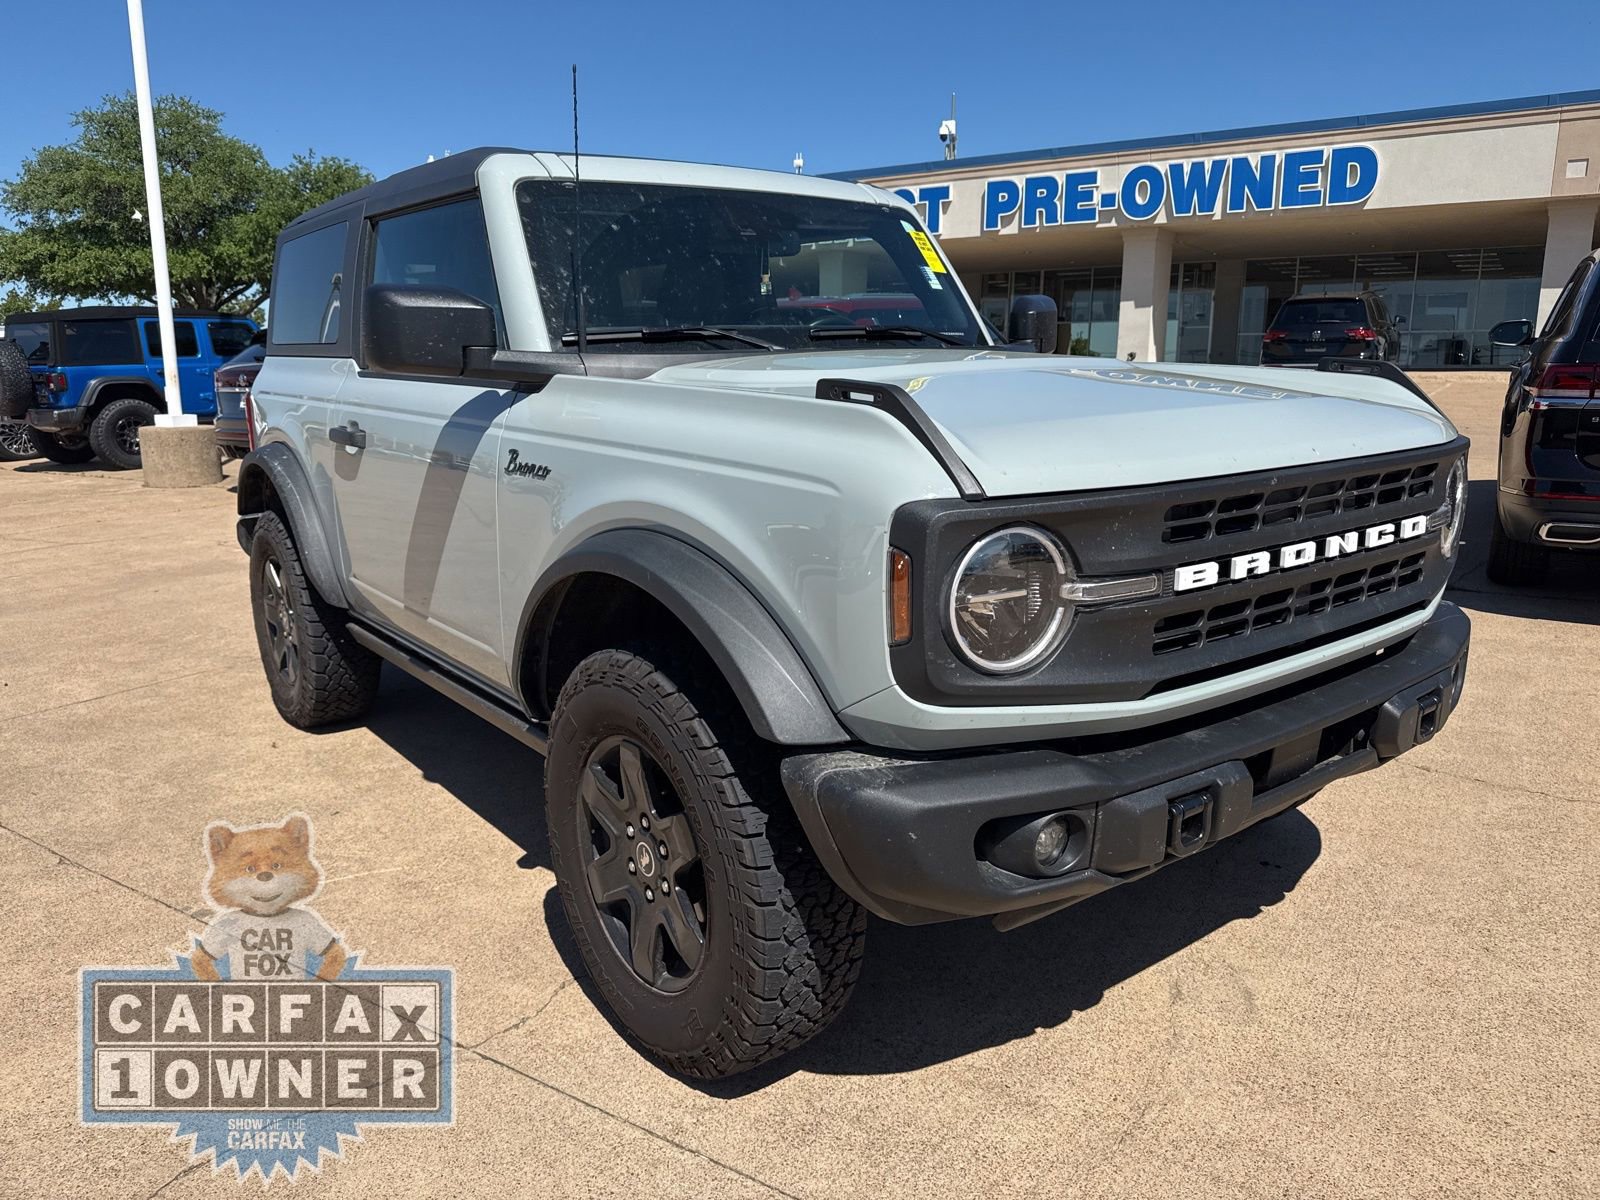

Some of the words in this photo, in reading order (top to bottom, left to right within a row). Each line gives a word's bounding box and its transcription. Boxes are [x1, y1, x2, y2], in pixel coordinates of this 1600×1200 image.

[984, 145, 1379, 230] PRE-OWNED
[504, 448, 552, 480] Bronco
[1174, 514, 1427, 592] BRONCO
